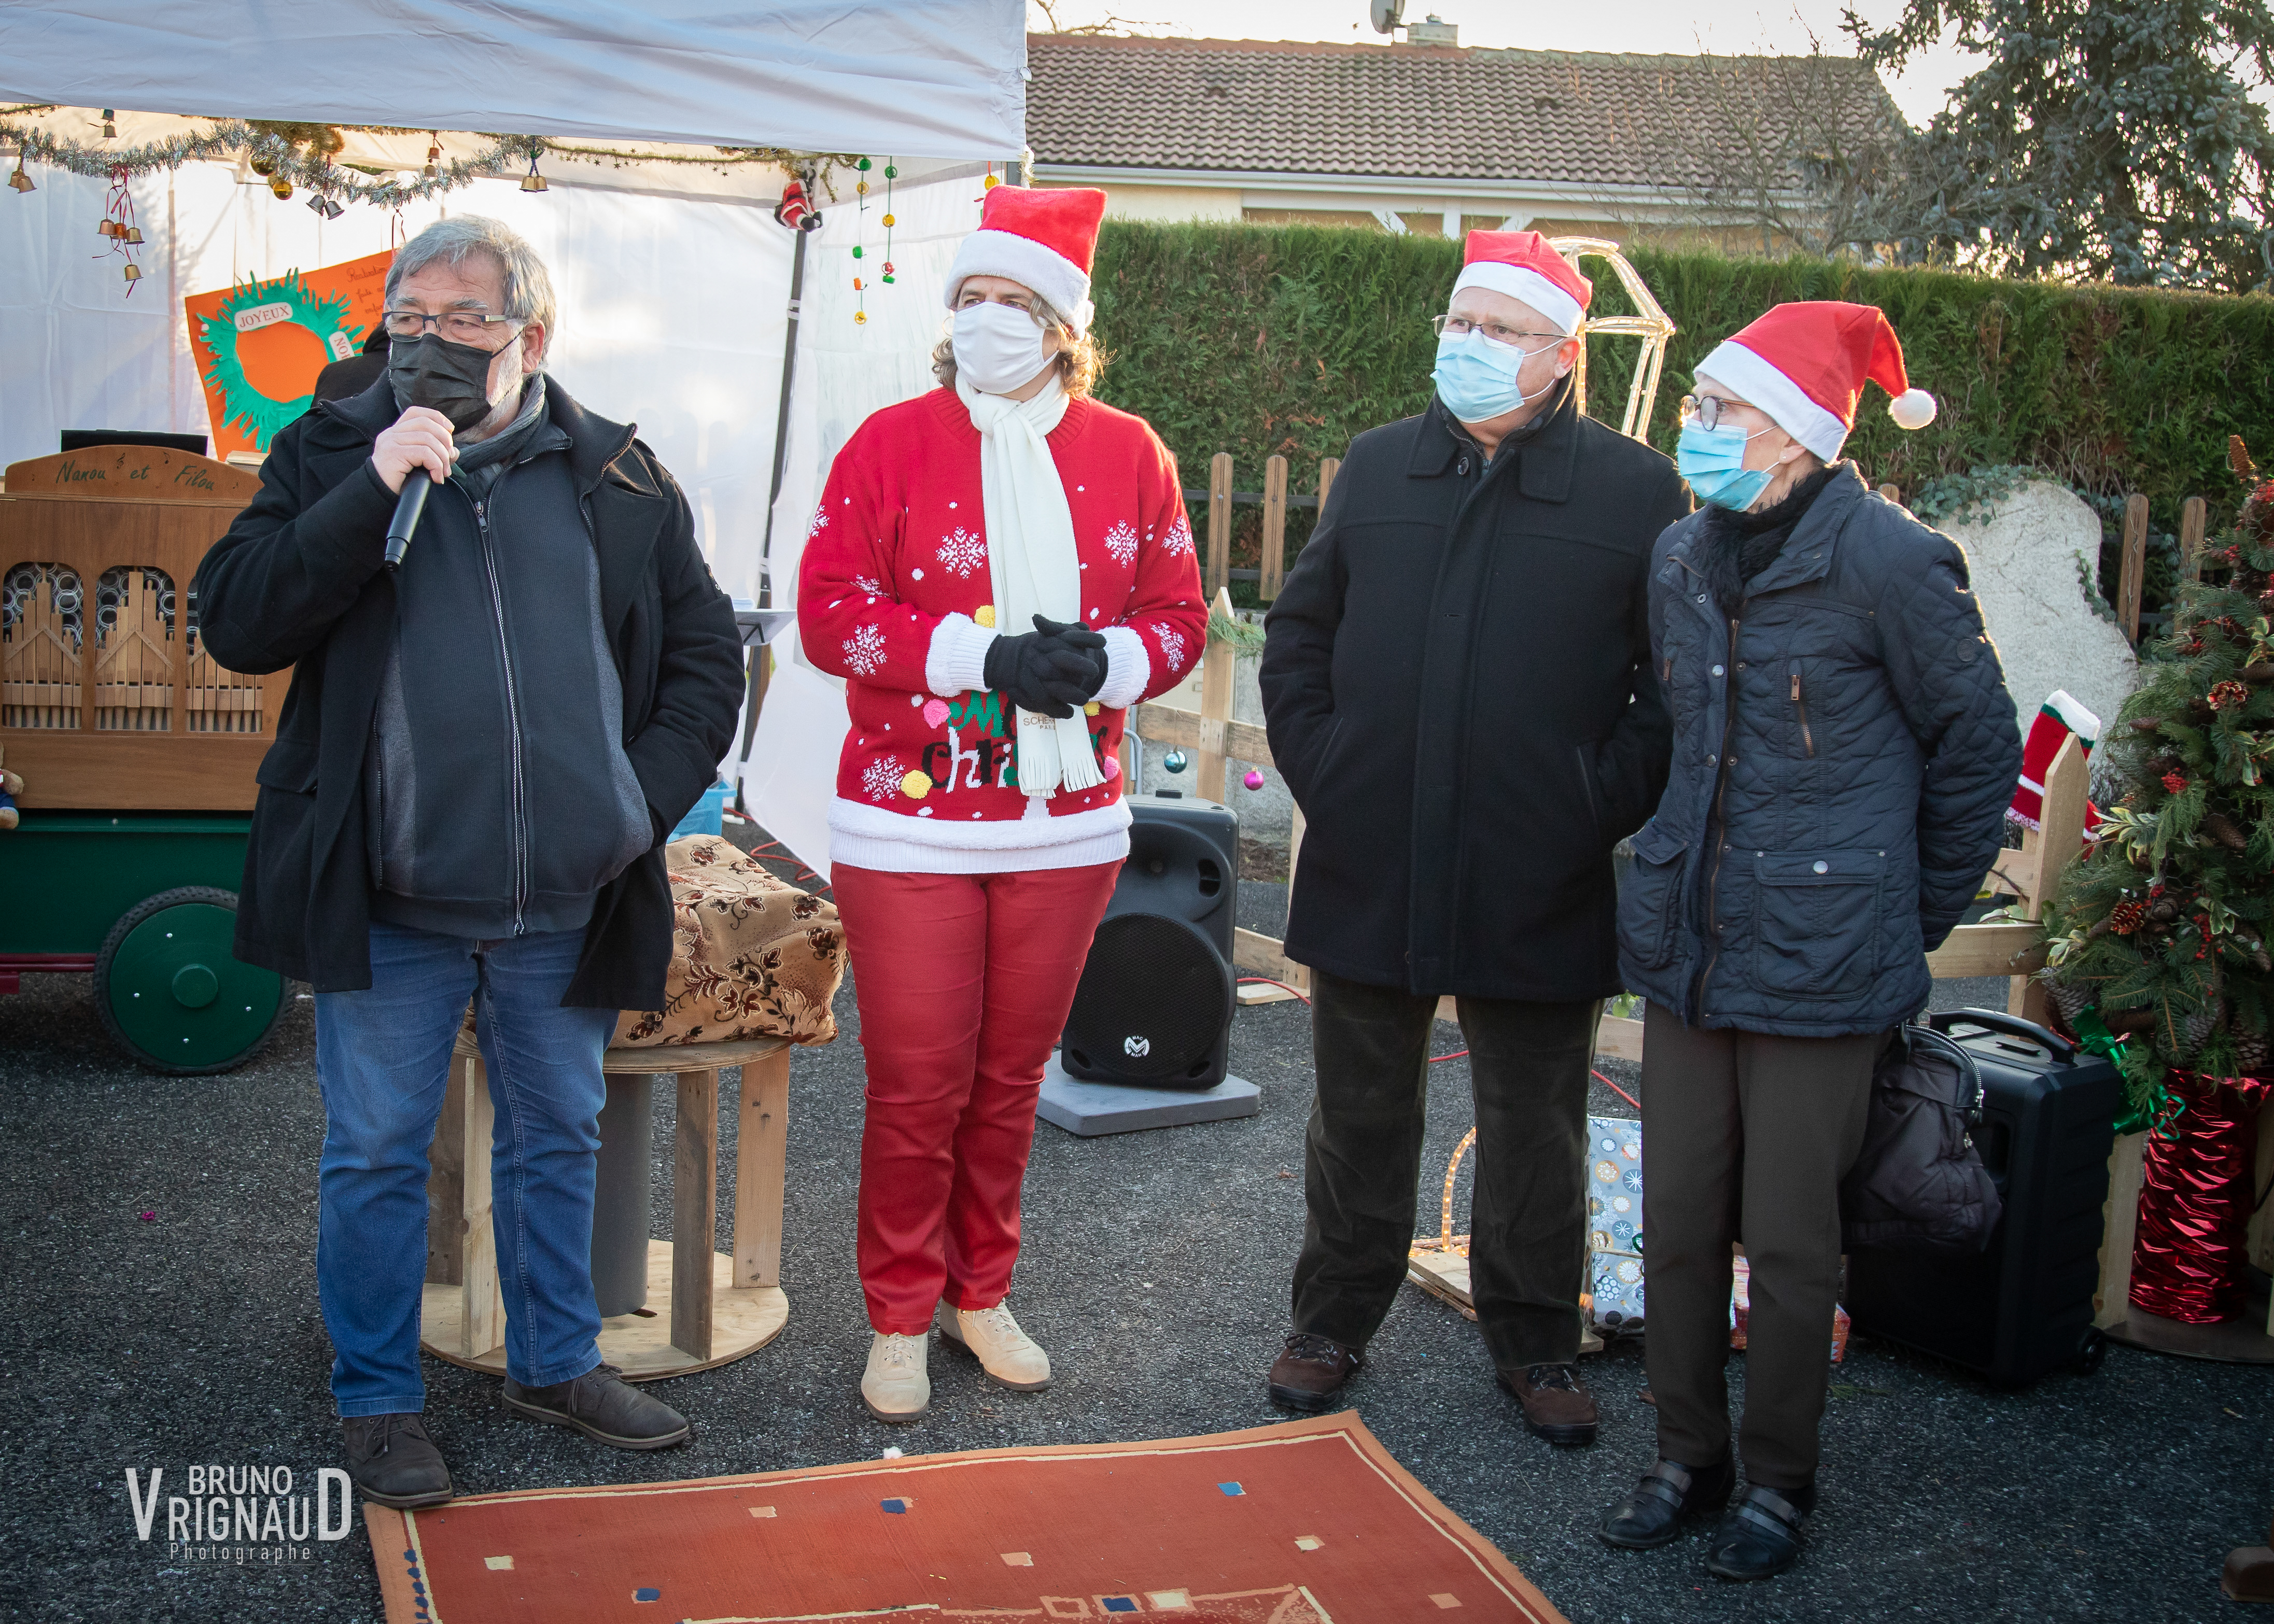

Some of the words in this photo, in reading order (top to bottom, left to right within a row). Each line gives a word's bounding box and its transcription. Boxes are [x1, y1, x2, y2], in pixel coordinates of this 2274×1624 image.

[240, 305, 290, 328] JOYEUX
[55, 459, 106, 484] Nanou
[130, 464, 151, 480] et
[174, 465, 215, 491] Filou
